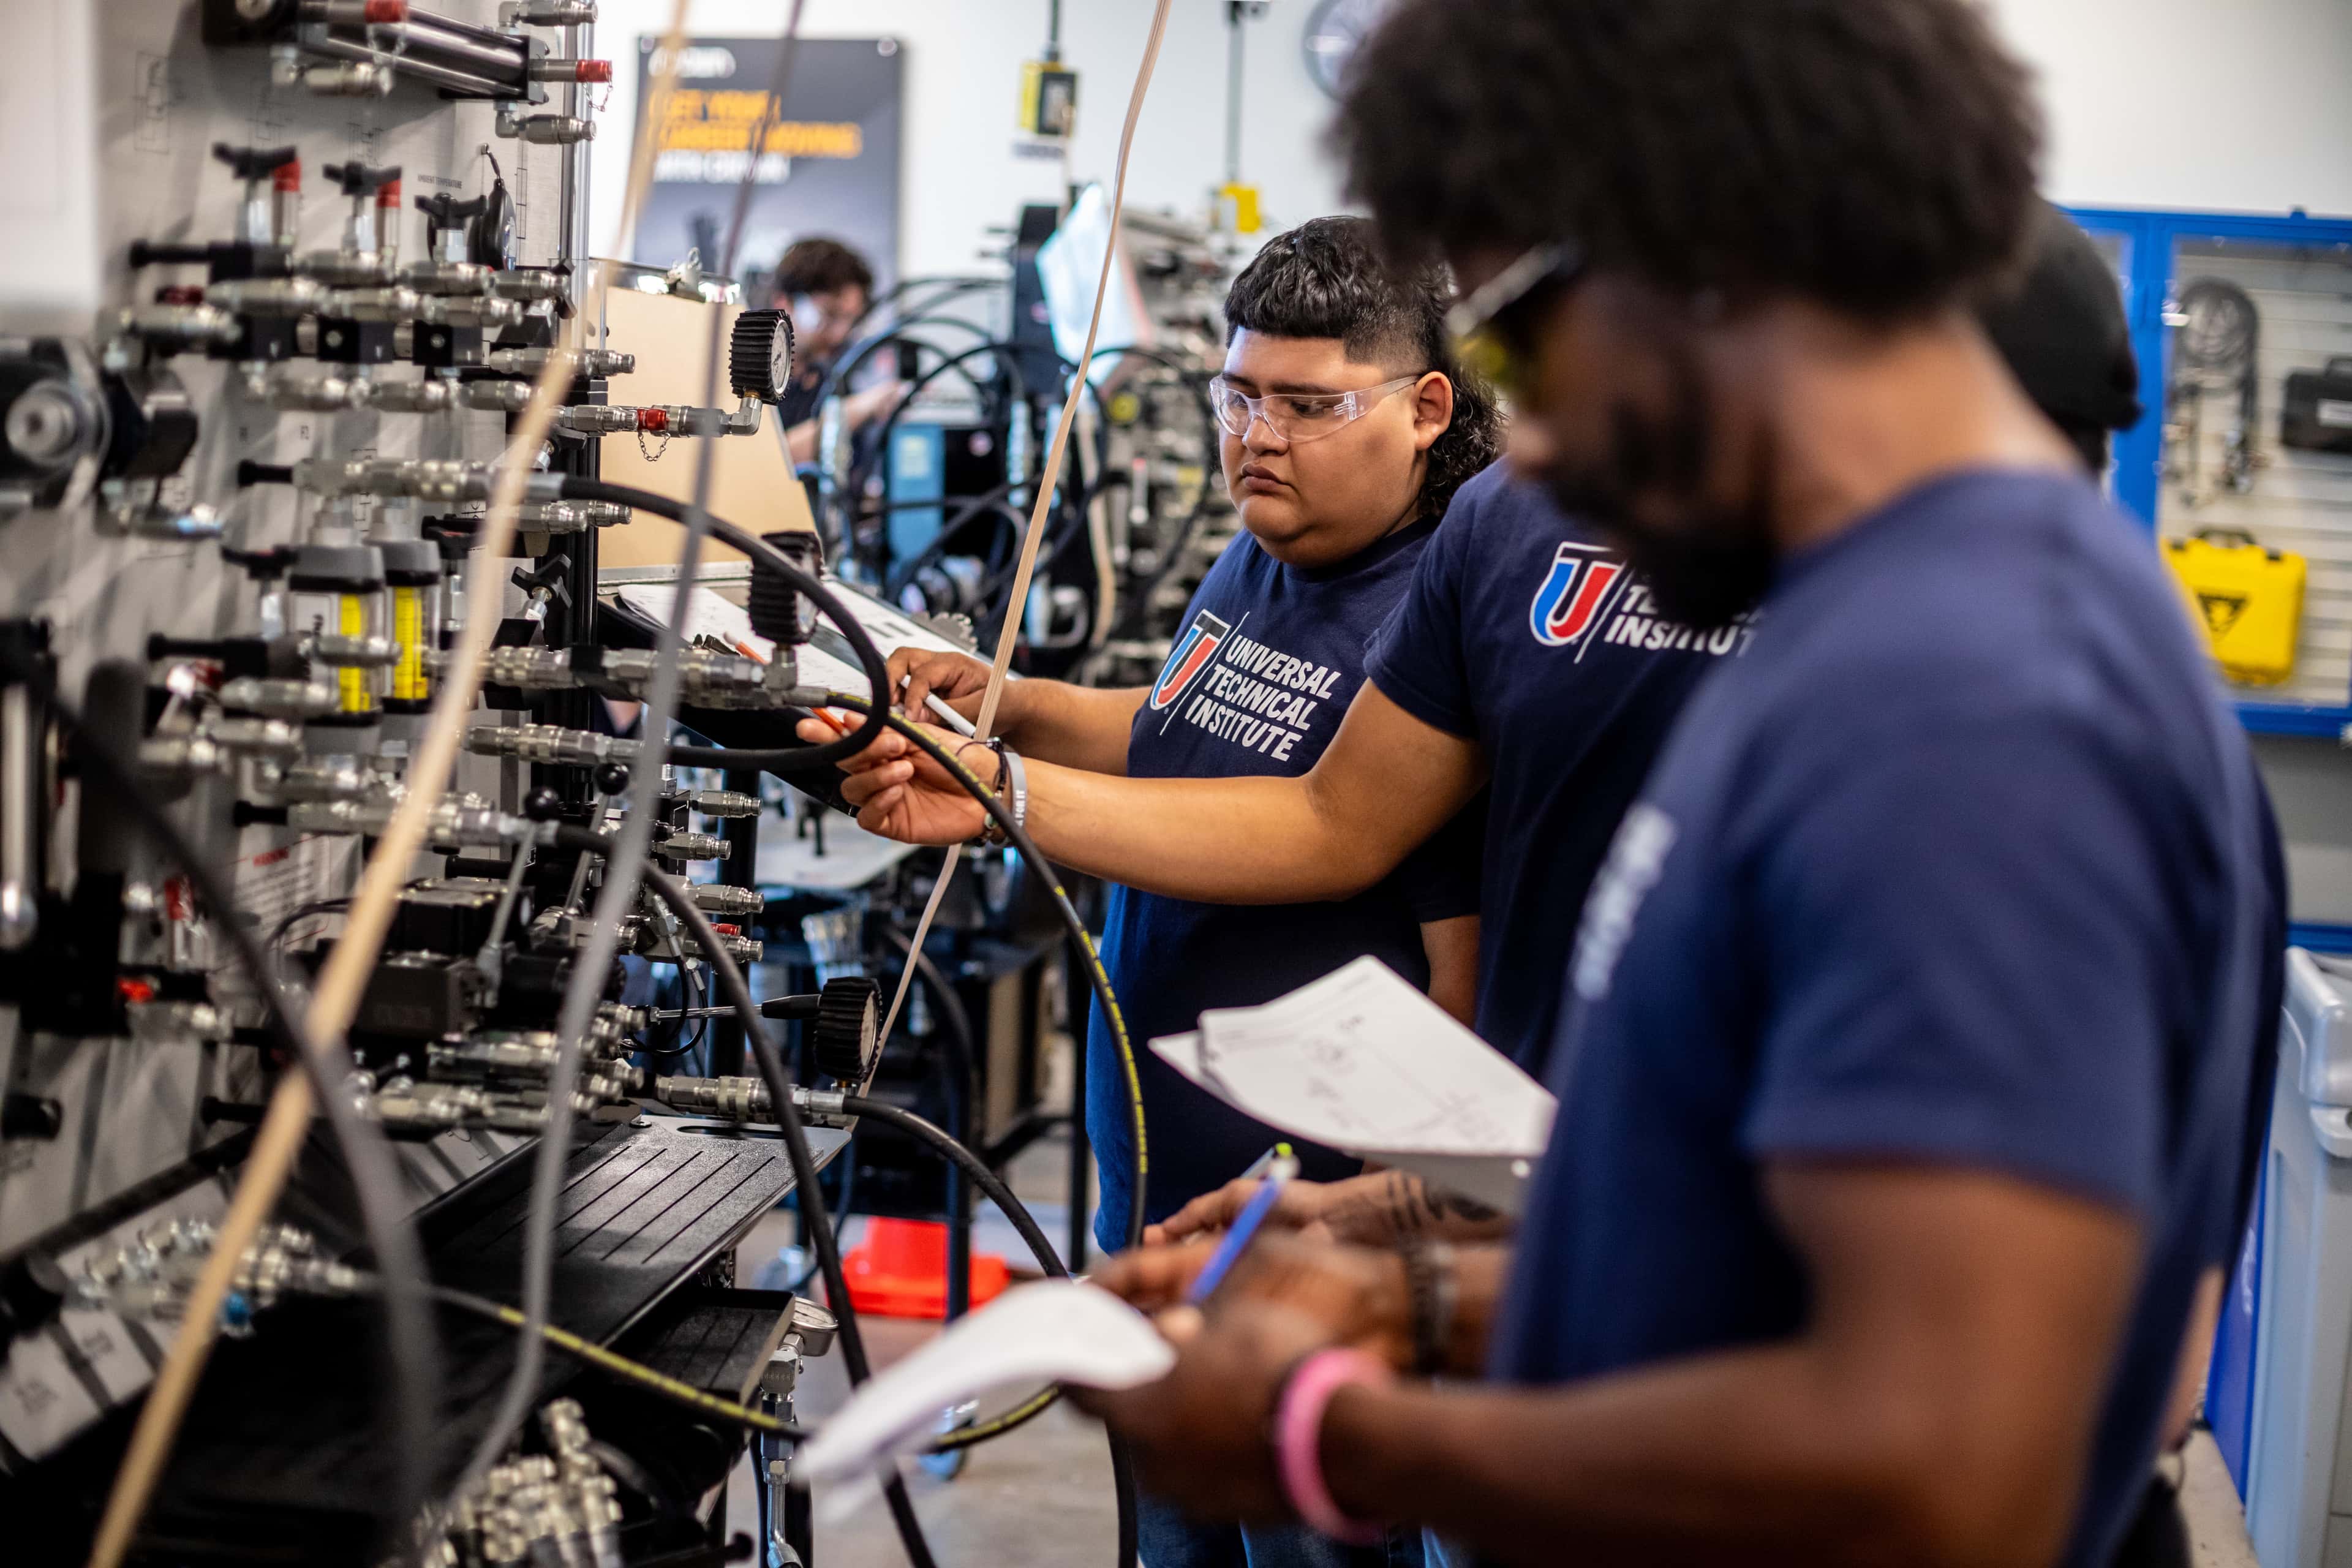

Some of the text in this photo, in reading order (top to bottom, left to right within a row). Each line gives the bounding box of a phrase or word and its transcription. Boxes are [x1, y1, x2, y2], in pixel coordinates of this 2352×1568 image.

[1204, 663, 1317, 731] TECHNICAL
[1225, 635, 1341, 699] UNIVERSAL
[1184, 693, 1303, 762] INSTITUTE
